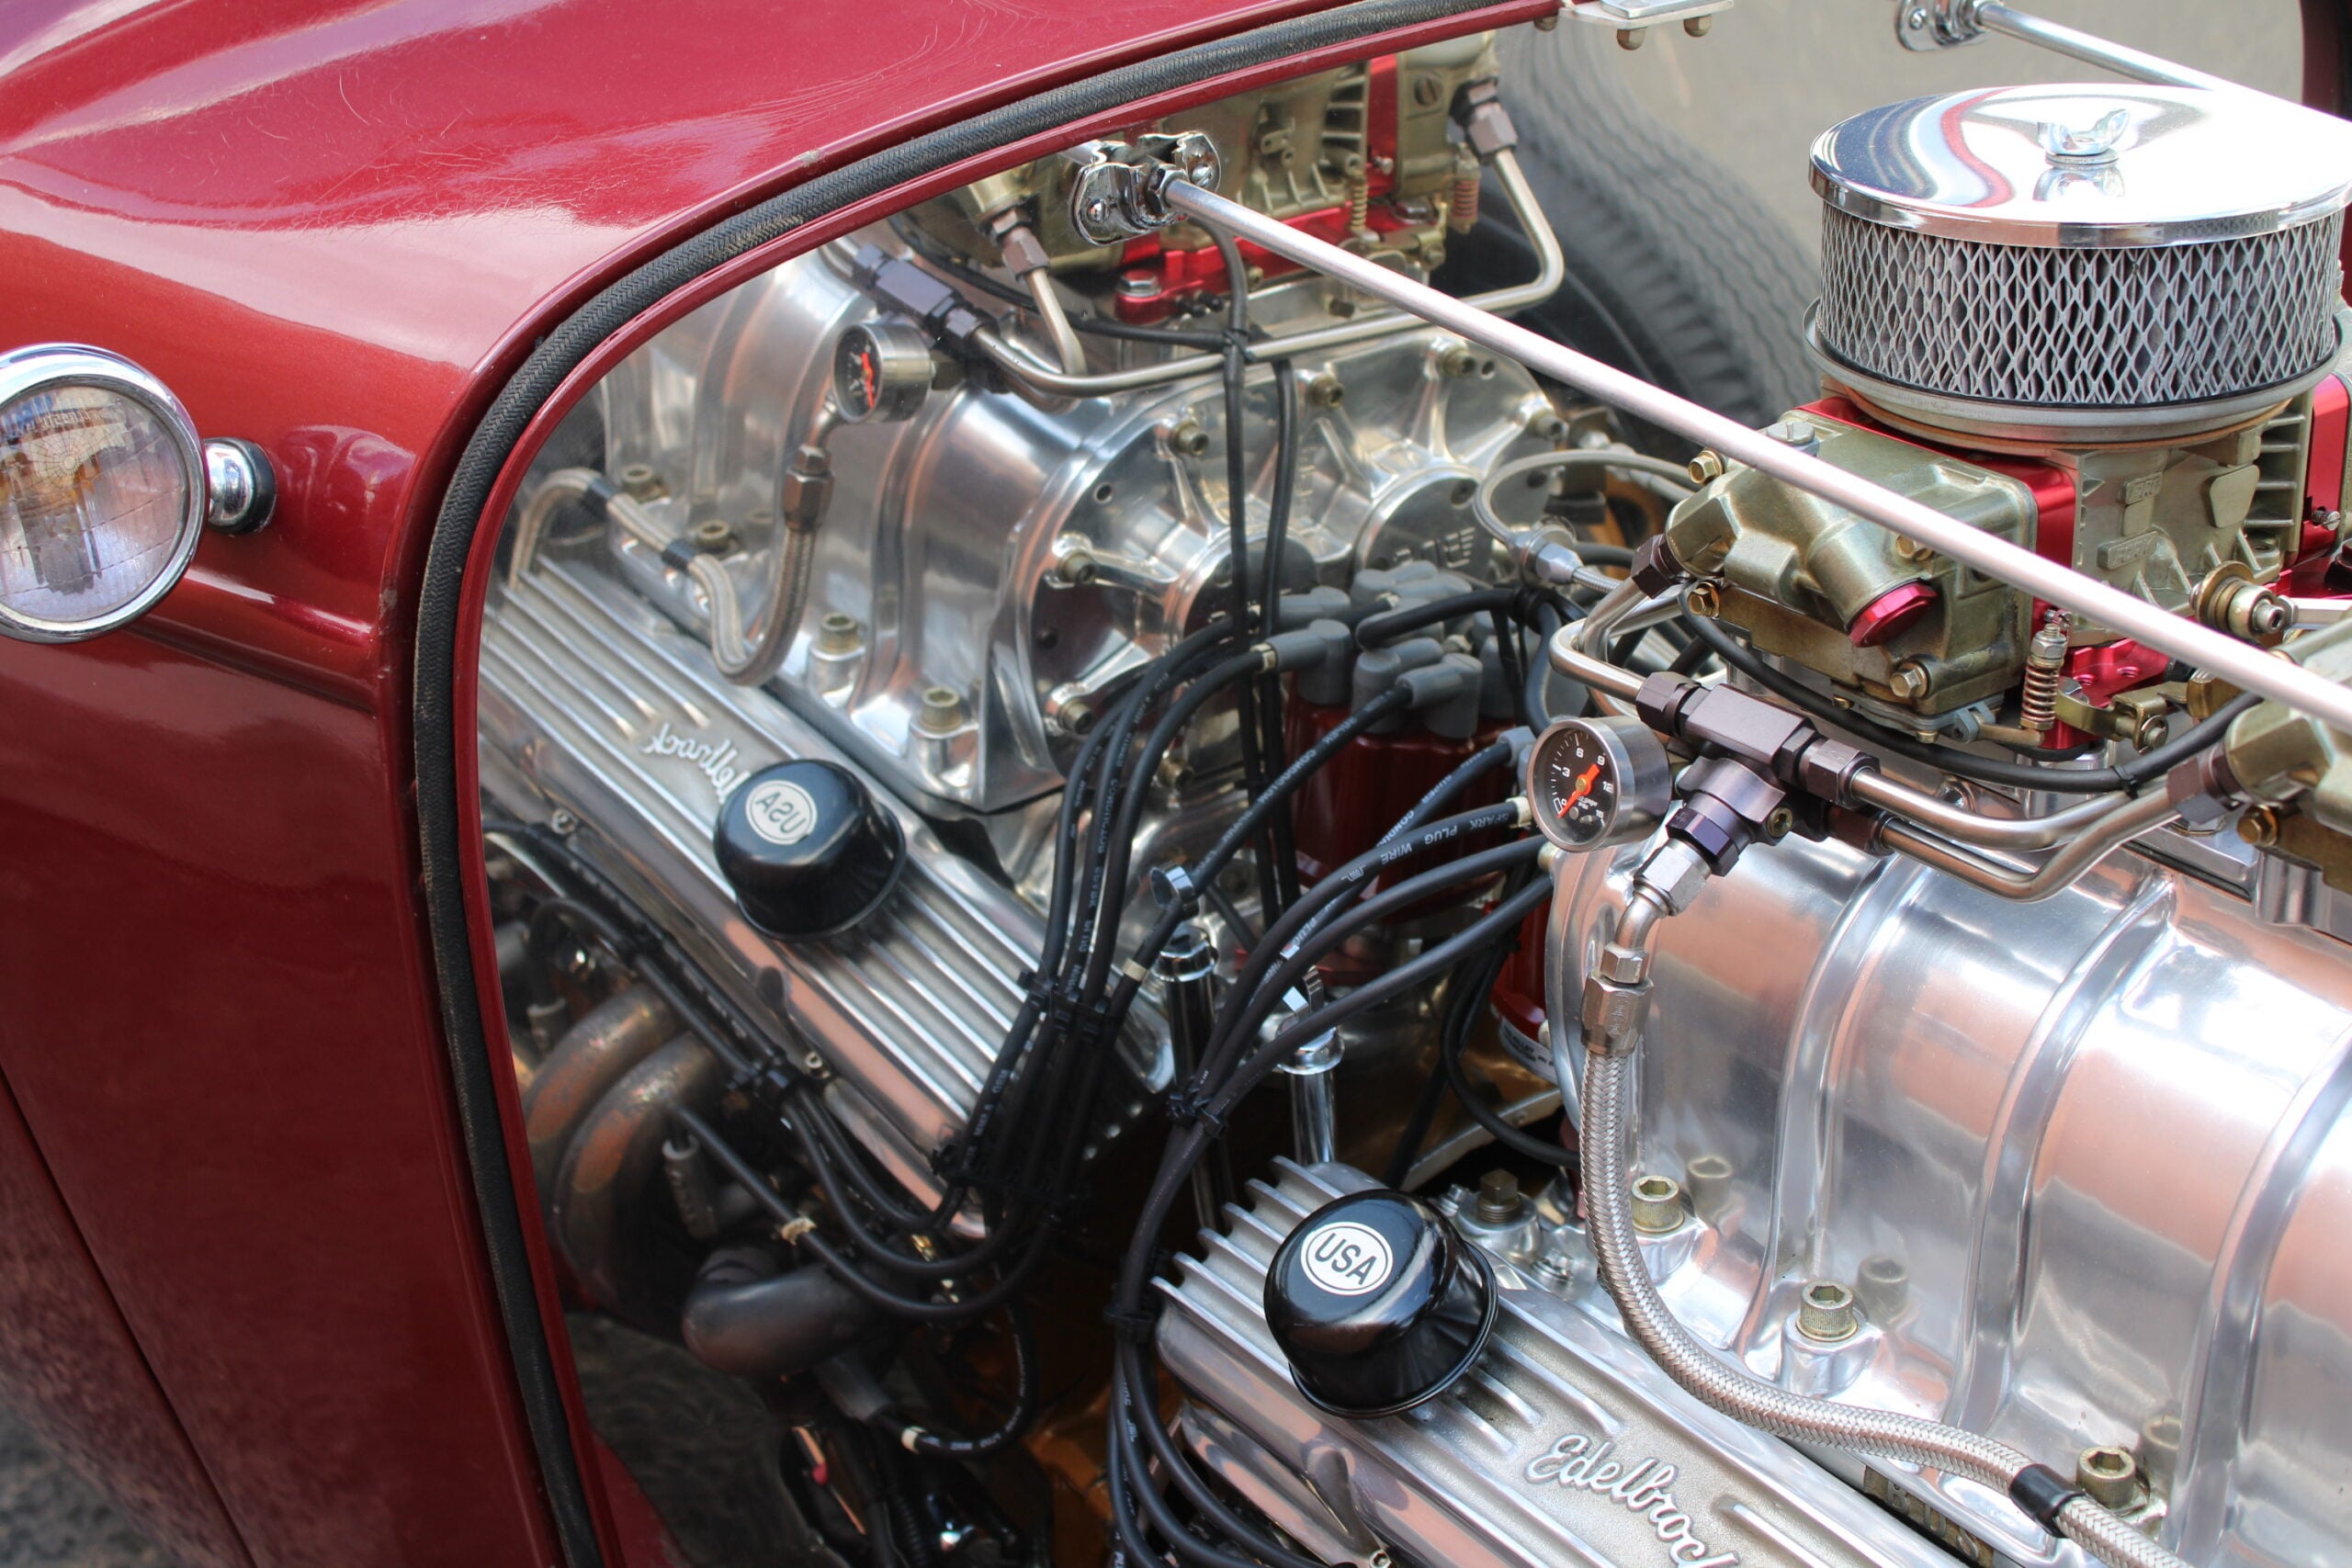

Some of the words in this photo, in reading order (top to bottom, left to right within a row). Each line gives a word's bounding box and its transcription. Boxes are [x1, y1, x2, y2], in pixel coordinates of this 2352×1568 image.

[1576, 749, 1584, 759] 6
[1597, 755, 1606, 766] 9
[1257, 749, 1317, 804] CONDUCTOR
[1562, 767, 1571, 778] 3
[1602, 781, 1614, 794] 12
[1469, 812, 1510, 830] SPARK
[1424, 824, 1459, 845] PLUG
[1380, 842, 1414, 865] WIRE
[1315, 1232, 1376, 1285] USA
